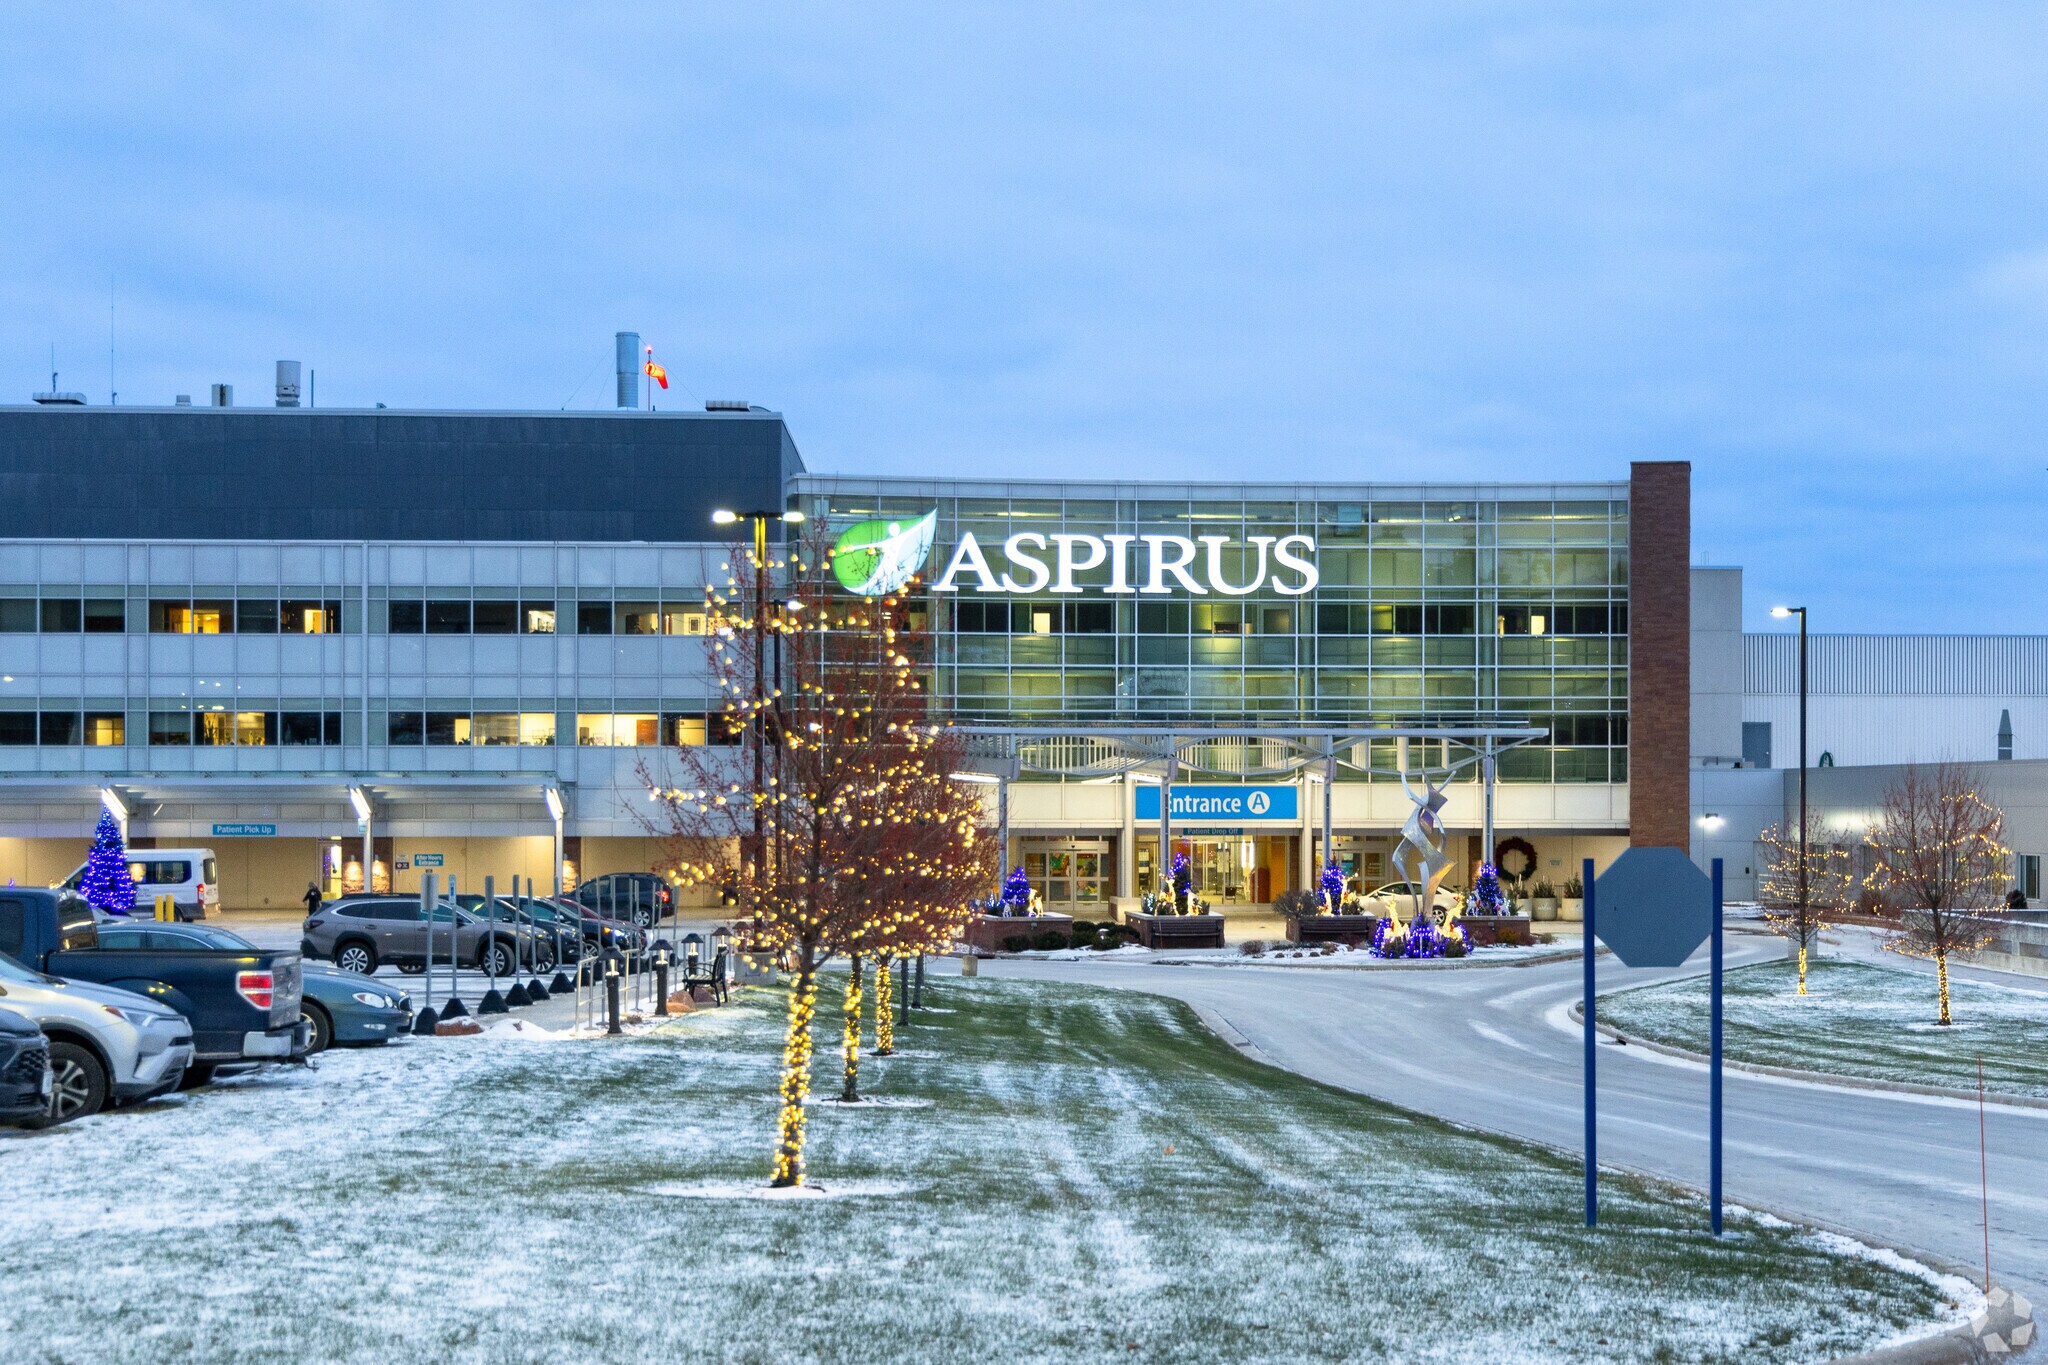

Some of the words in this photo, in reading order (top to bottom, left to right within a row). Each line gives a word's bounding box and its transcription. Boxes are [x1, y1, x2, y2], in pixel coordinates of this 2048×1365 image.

[932, 531, 1320, 596] ASPIRUS
[1169, 792, 1242, 813] ntrance
[217, 825, 243, 834] Patient
[244, 825, 260, 834] Pick
[261, 825, 272, 835] Up
[1211, 828, 1228, 836] Drop
